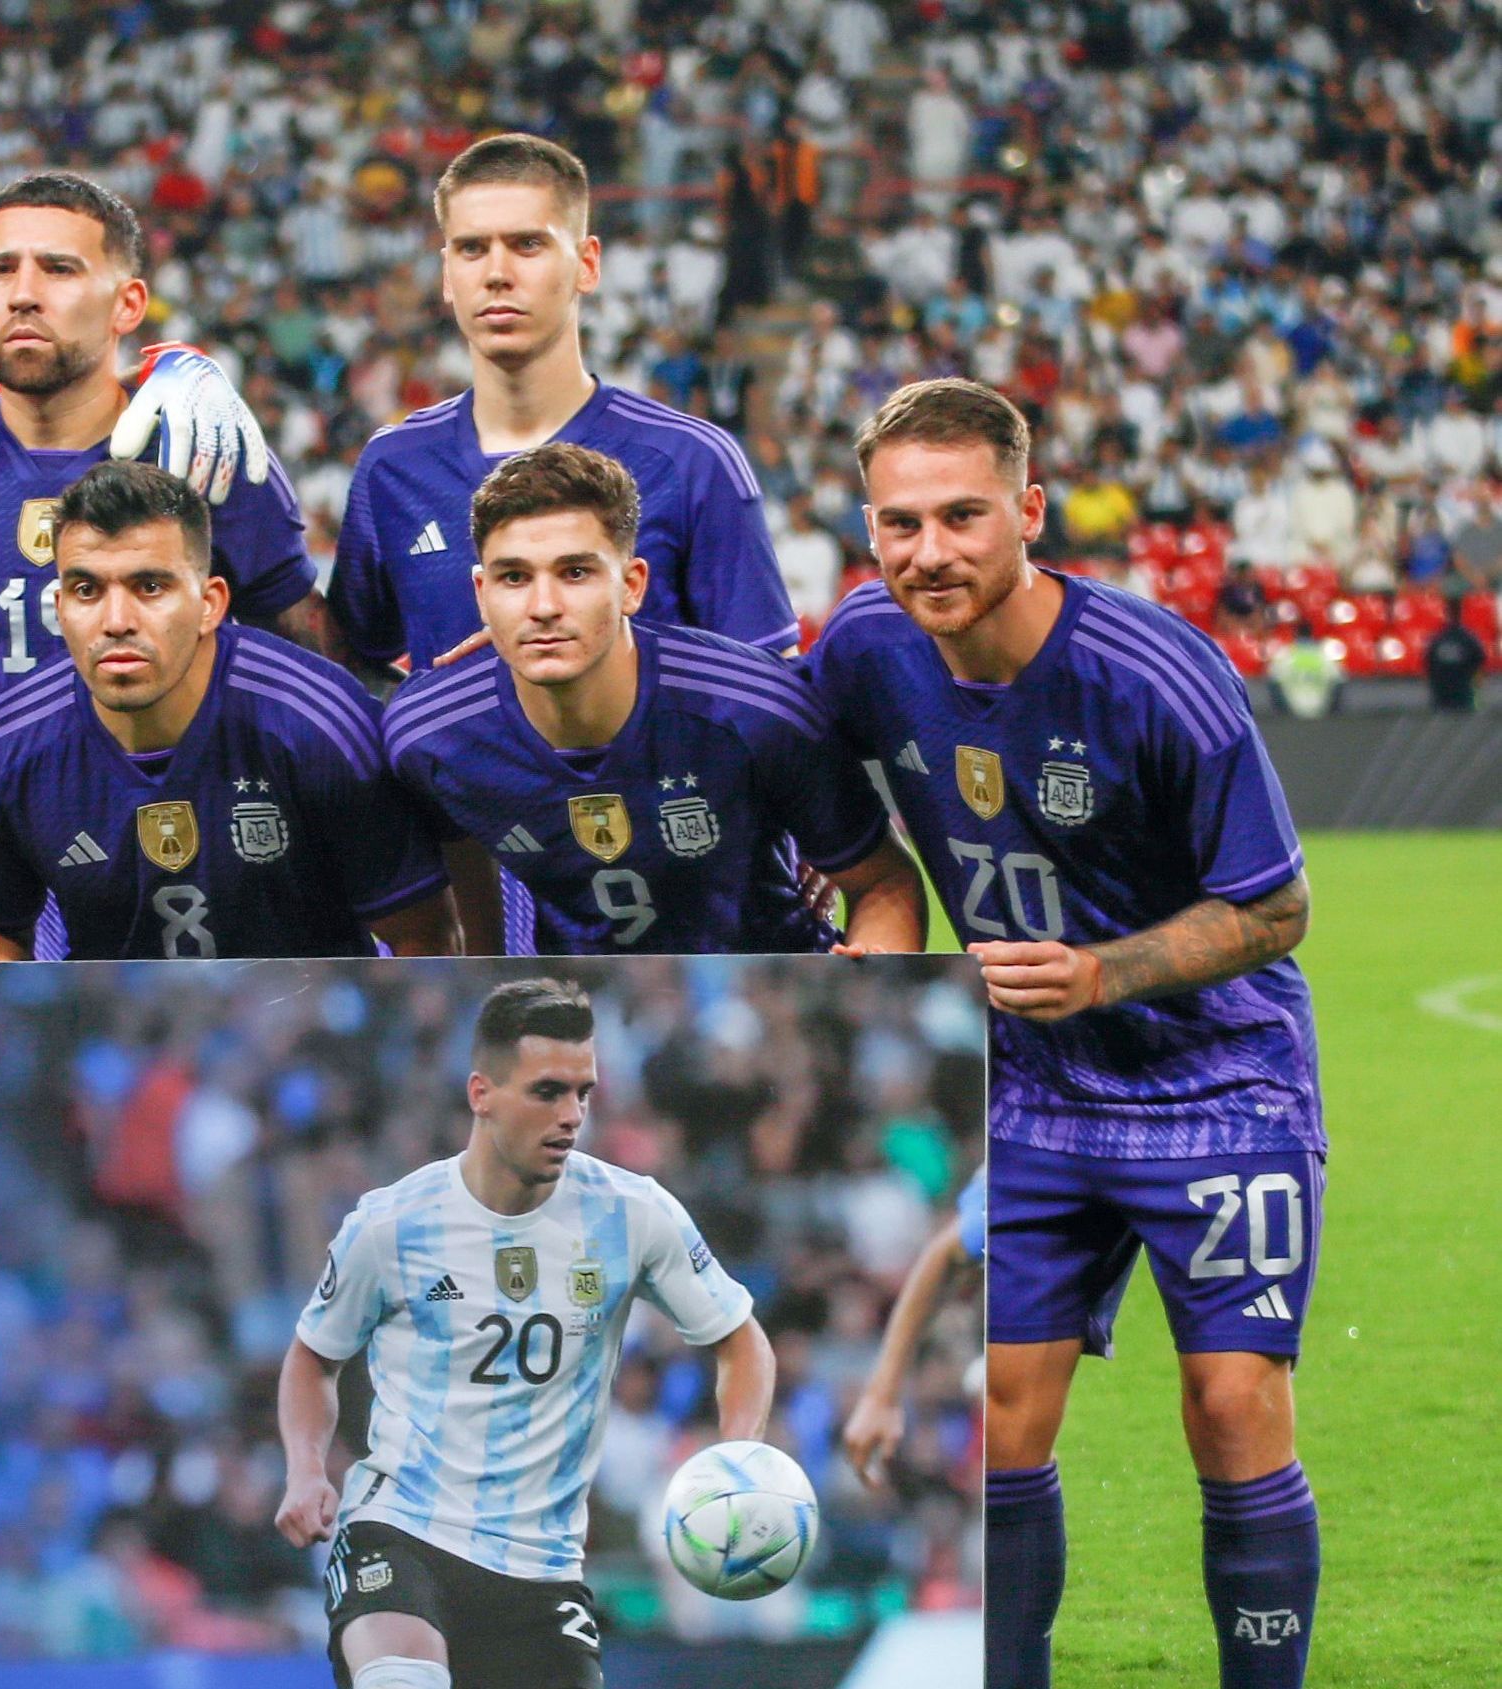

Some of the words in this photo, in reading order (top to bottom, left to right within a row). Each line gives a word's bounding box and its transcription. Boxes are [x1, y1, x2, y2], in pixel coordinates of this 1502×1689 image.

[1050, 778, 1081, 808] AFA
[245, 820, 275, 847] AFA
[675, 816, 706, 841] AFA
[591, 868, 657, 945] 9
[947, 836, 1065, 942] 20
[152, 884, 217, 959] 8
[1186, 1172, 1303, 1279] 20
[426, 1290, 464, 1301] adidas
[575, 1271, 598, 1295] AFA
[470, 1312, 563, 1386] 20
[1233, 1606, 1301, 1646] AFA
